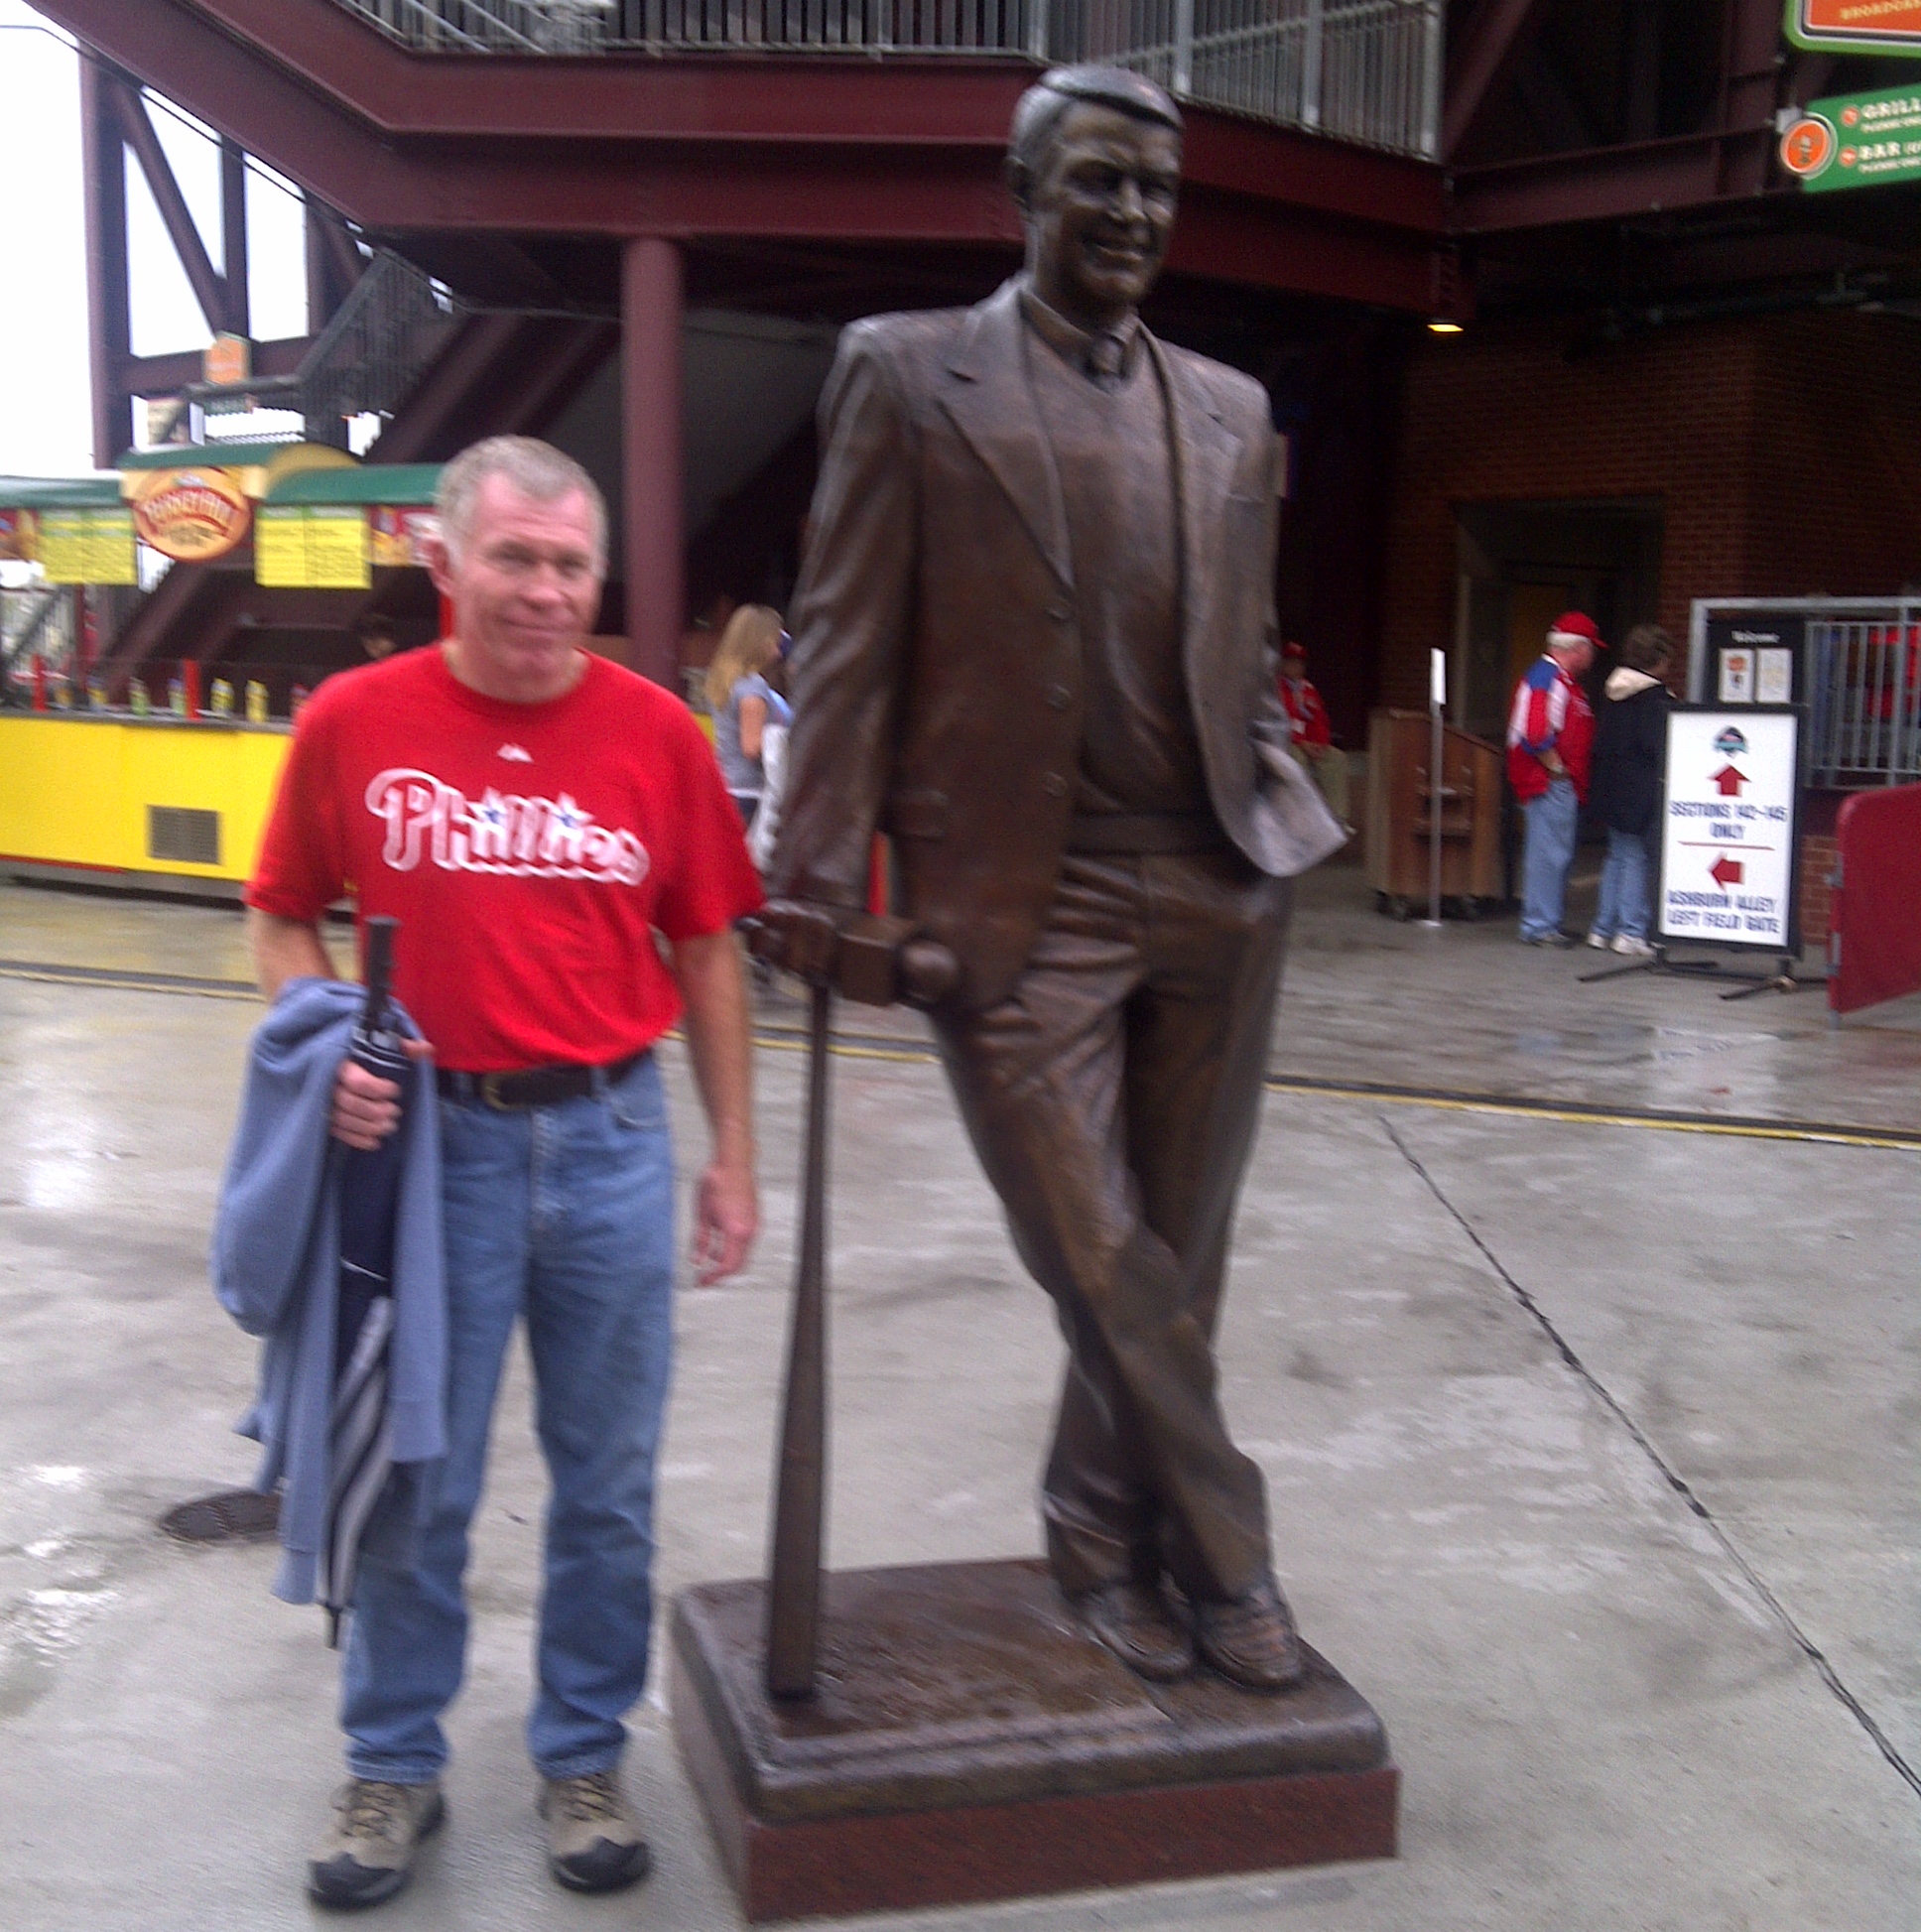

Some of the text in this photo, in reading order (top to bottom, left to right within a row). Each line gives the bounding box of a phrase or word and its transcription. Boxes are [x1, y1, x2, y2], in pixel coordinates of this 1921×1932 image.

[1858, 141, 1901, 161] BAR
[1669, 800, 1732, 819] SECTIONS
[365, 767, 651, 886] Phillies
[1710, 822, 1746, 839] ONLY
[1668, 889, 1778, 913] ASHBURN ALLEY
[1667, 908, 1782, 934] LEFT FIELD GATE
